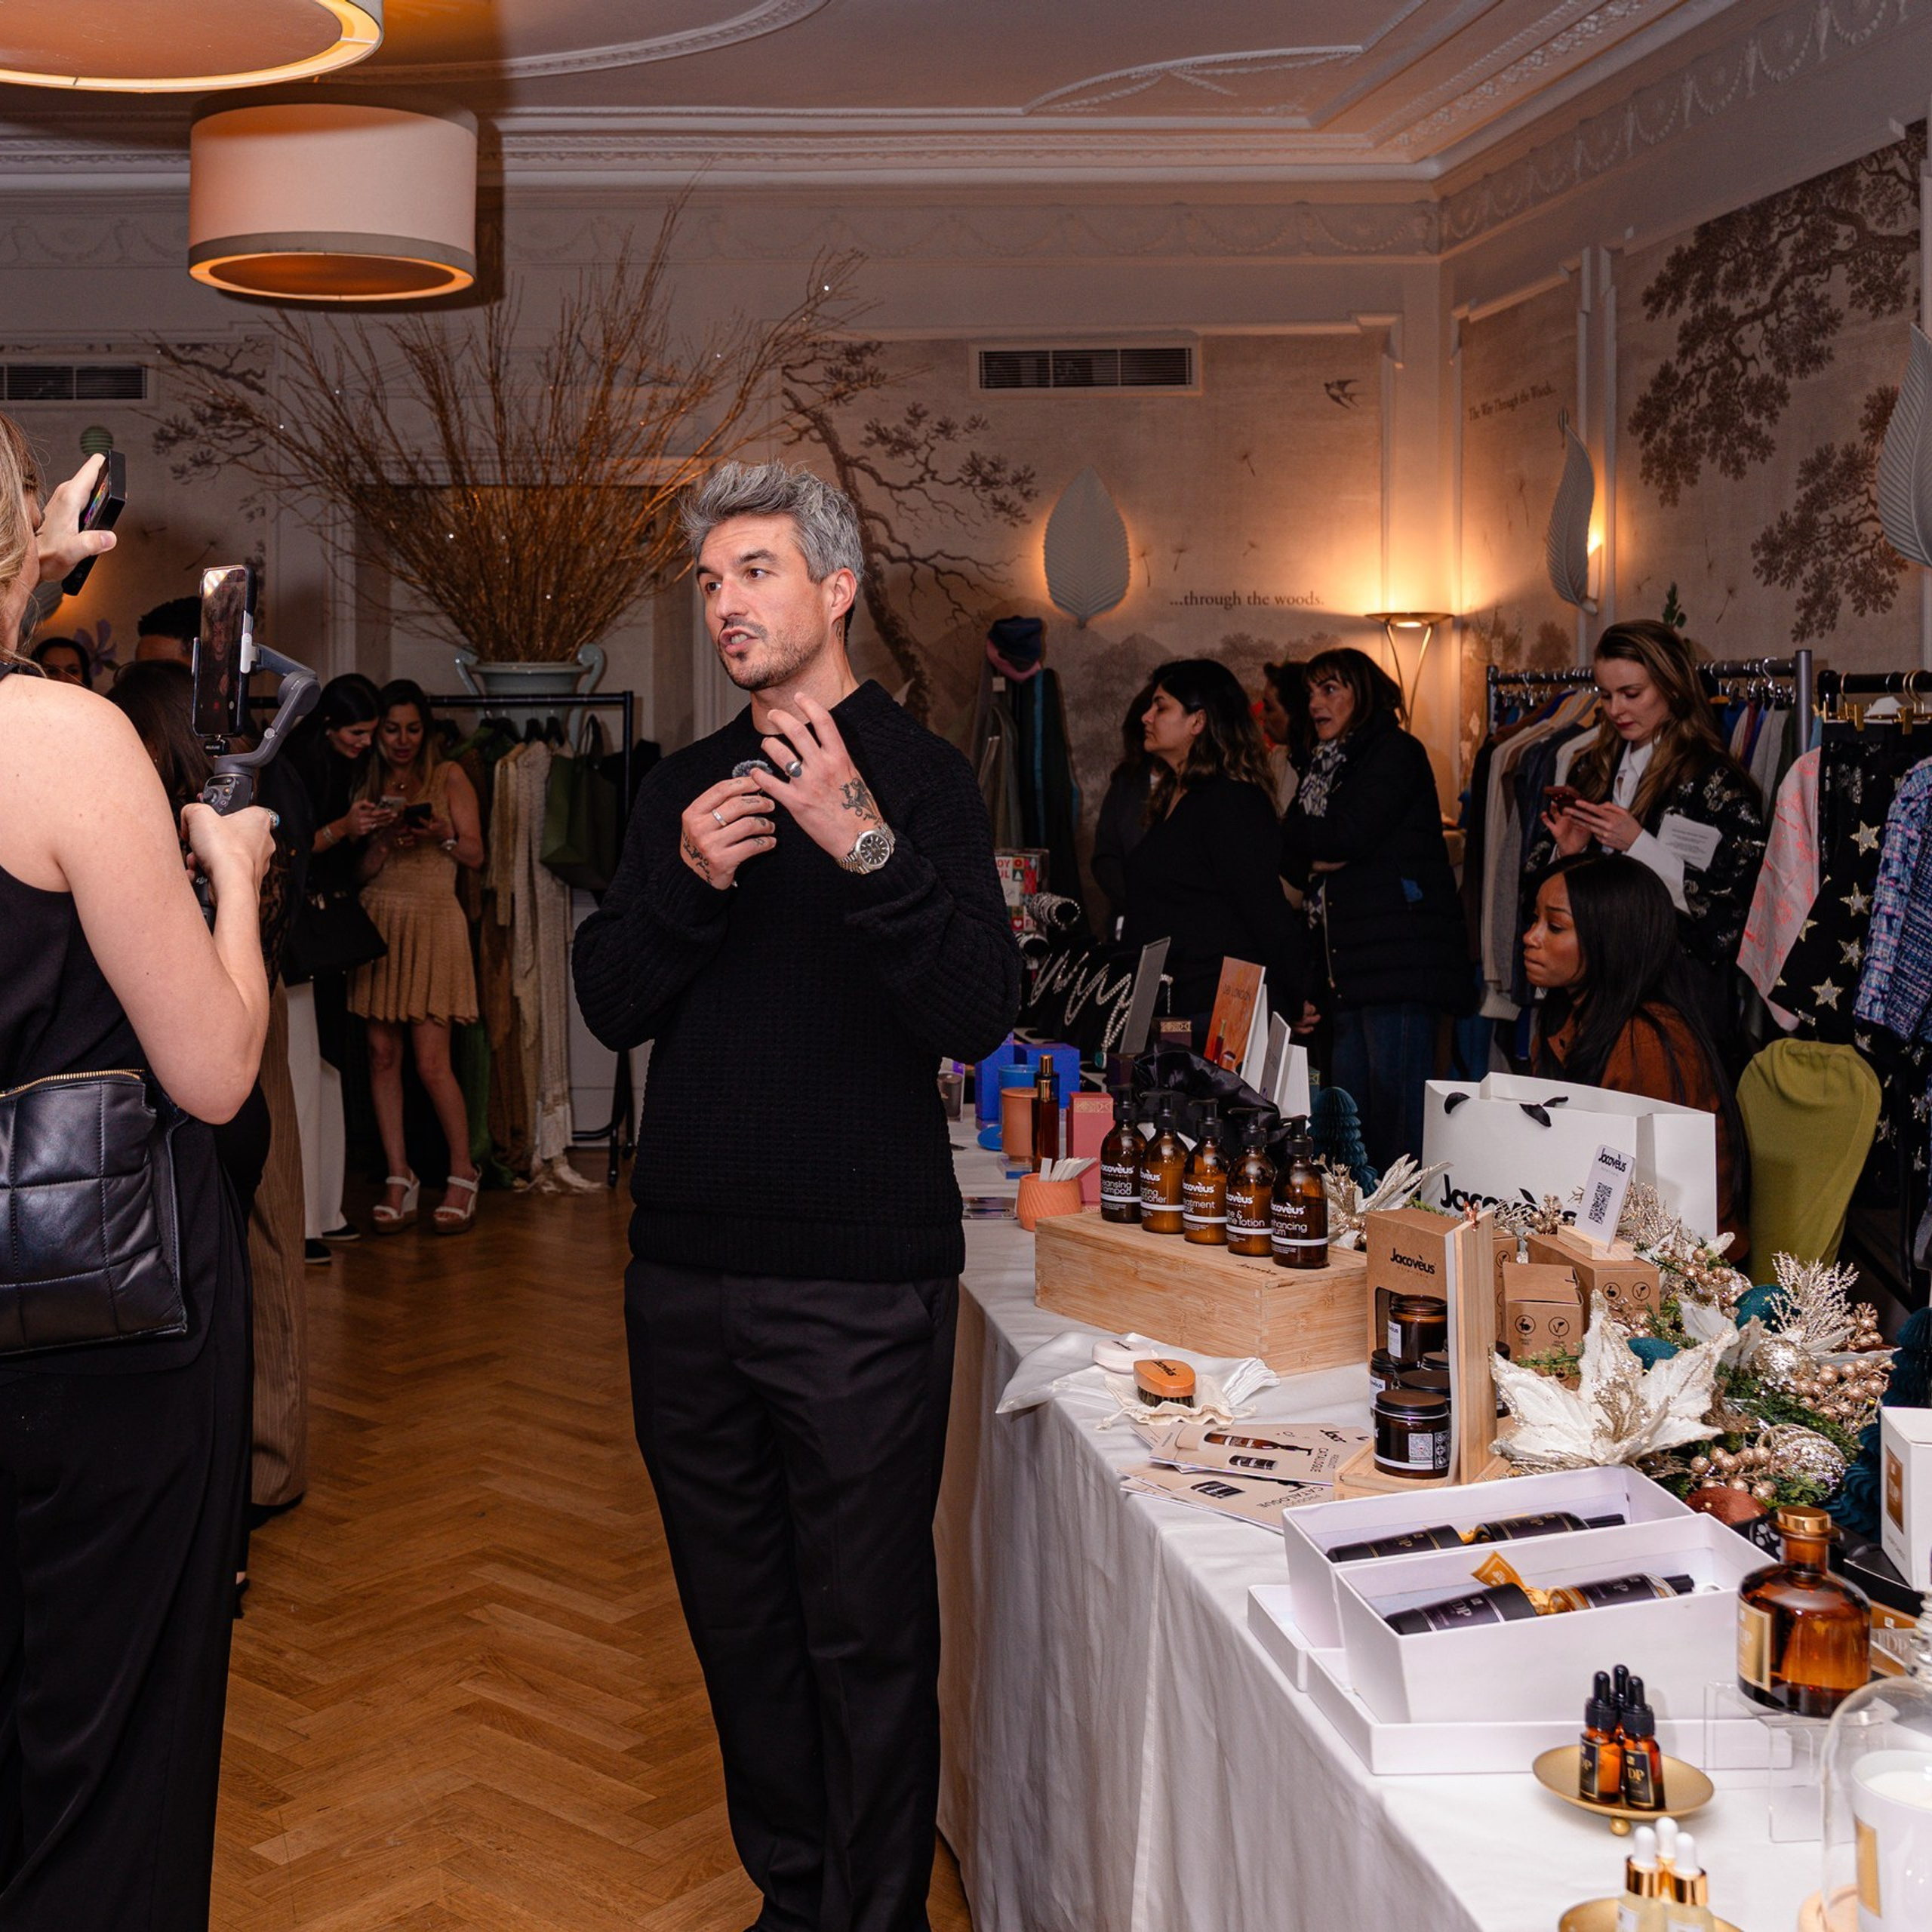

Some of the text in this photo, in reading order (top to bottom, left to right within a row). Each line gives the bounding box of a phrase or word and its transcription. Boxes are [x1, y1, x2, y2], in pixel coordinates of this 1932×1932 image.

[1170, 590, 1324, 611] ...through the woods.
[996, 859, 1011, 868] OY
[1237, 1210, 1243, 1220] &
[1239, 1217, 1266, 1227] lotion
[1390, 1247, 1437, 1275] Jacovèus
